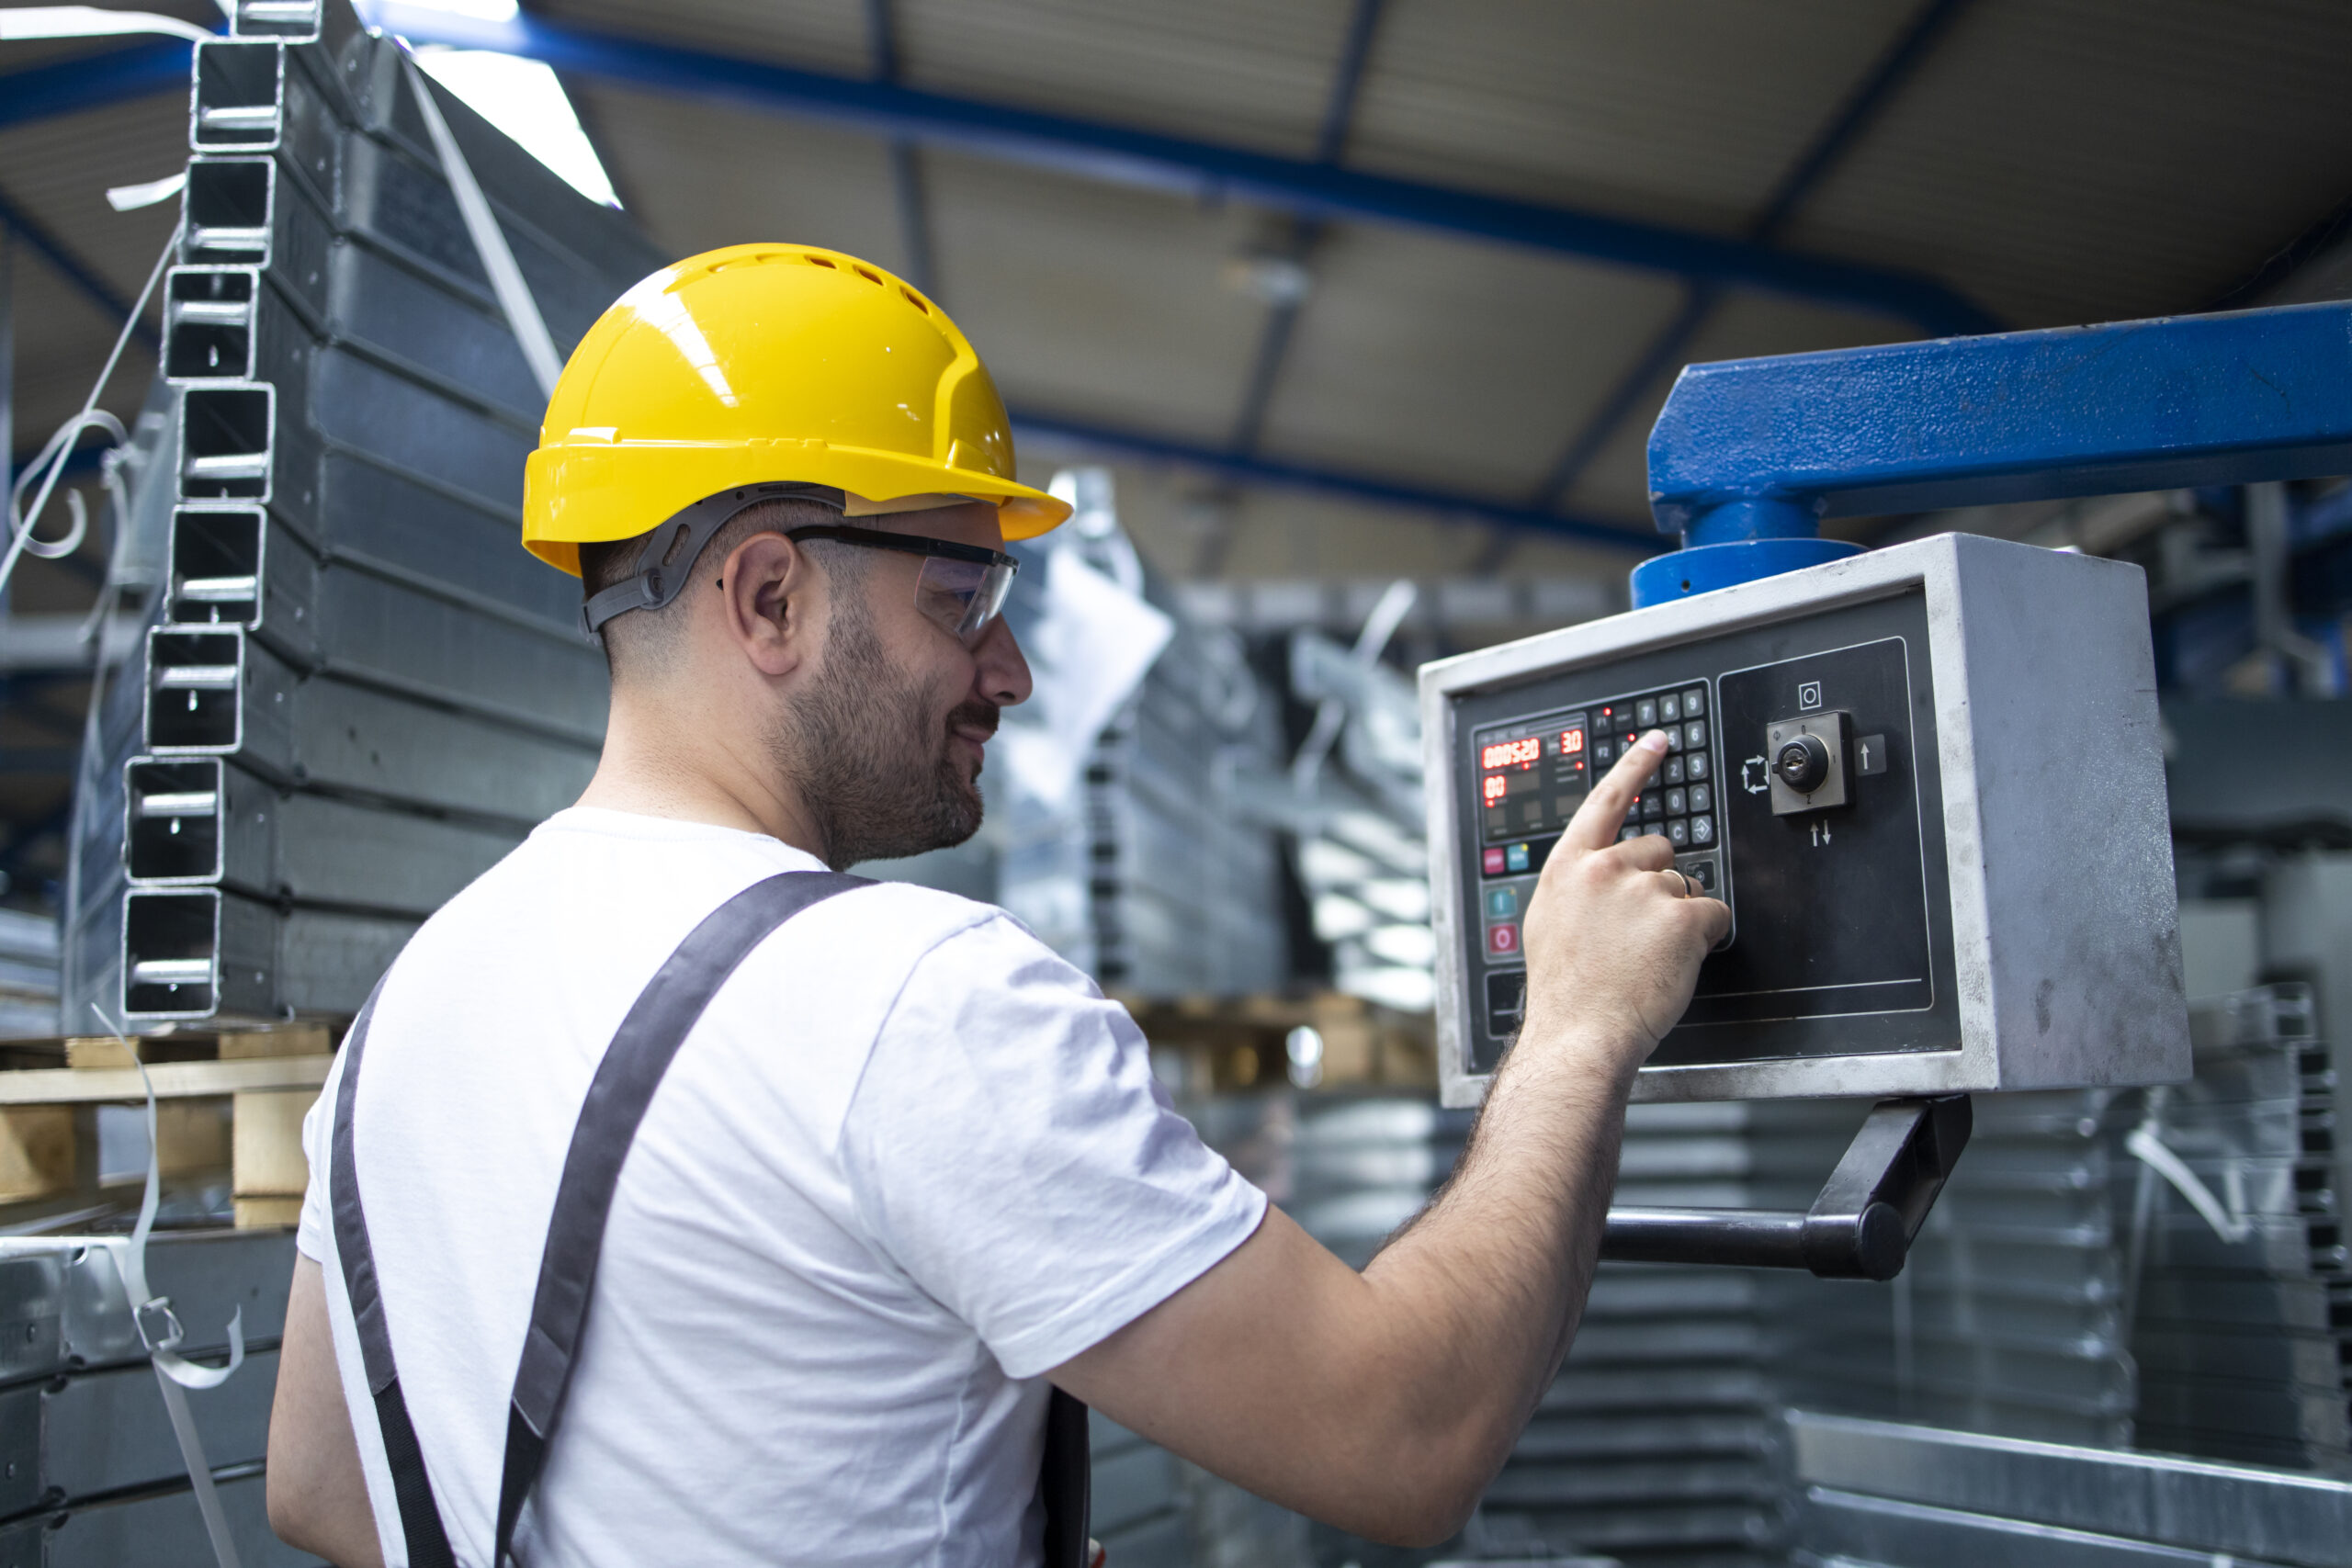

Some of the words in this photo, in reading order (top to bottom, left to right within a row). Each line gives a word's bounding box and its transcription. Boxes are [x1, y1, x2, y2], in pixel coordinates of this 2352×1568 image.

[1665, 701, 1674, 716] 8
[1689, 696, 1697, 710] 9
[1642, 705, 1651, 720] 7
[1668, 731, 1676, 746] 5
[1691, 728, 1700, 741] 6
[1669, 763, 1679, 777] 2
[1692, 759, 1702, 773] 3
[1673, 826, 1682, 840] C
